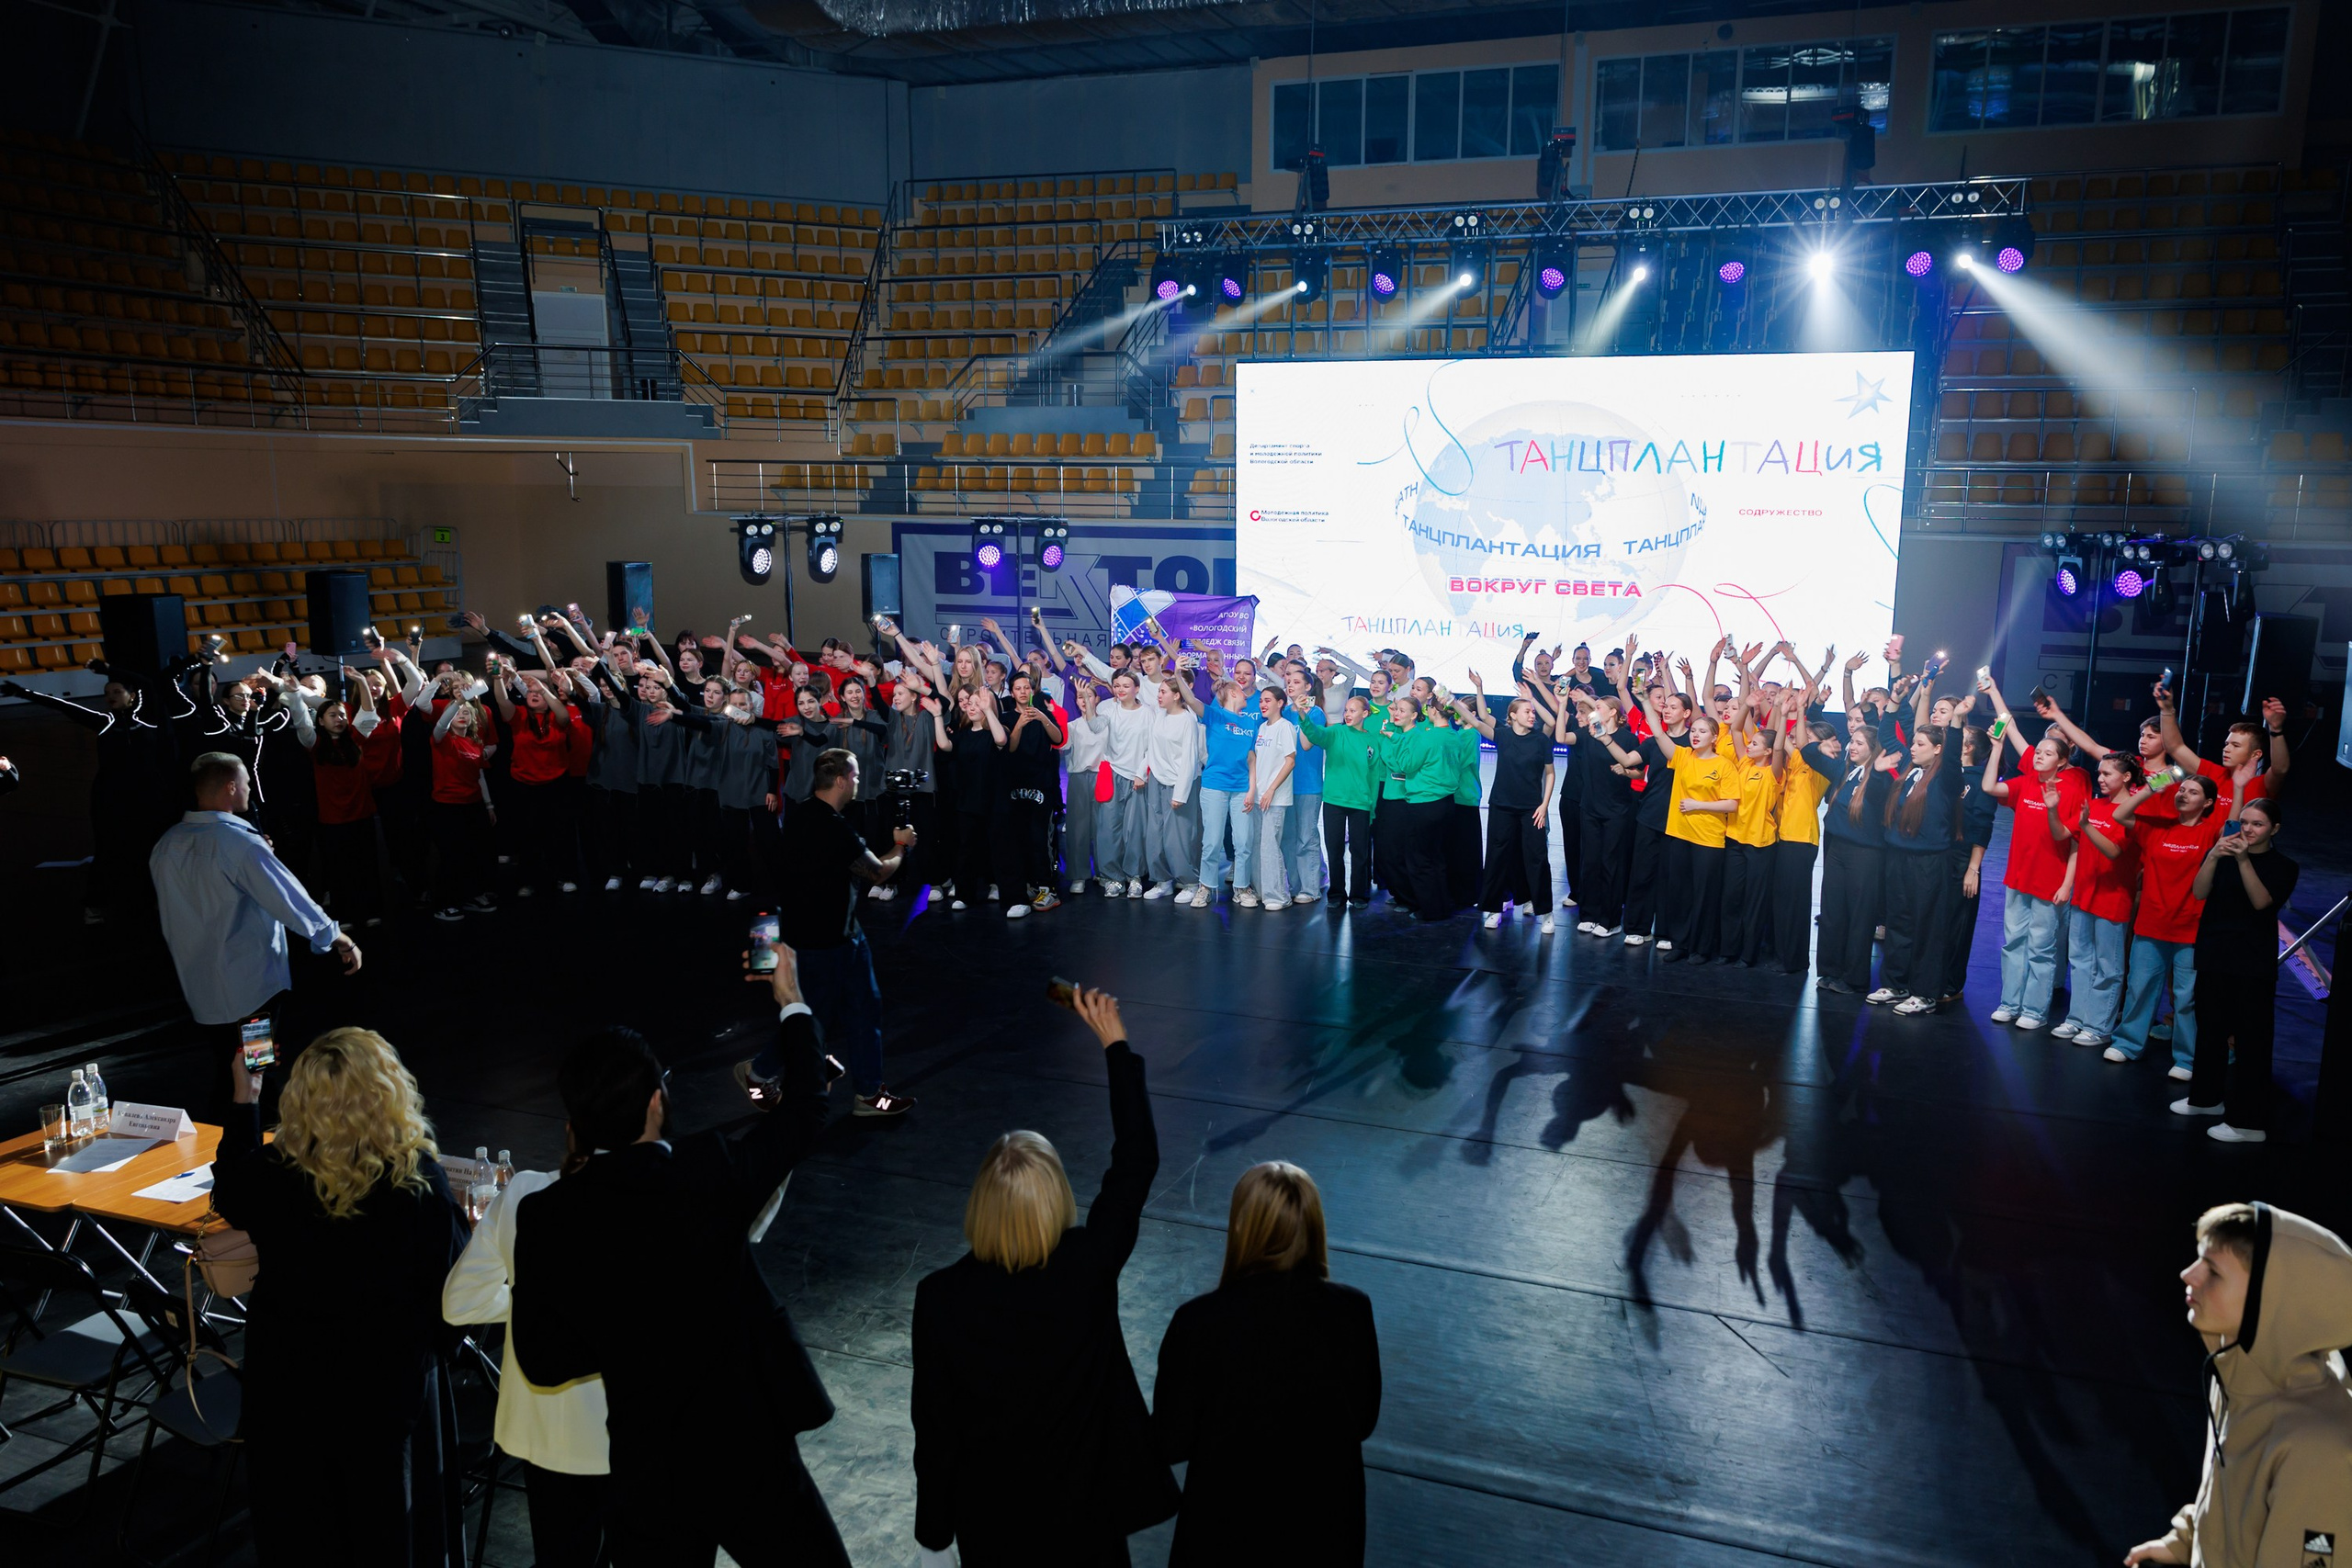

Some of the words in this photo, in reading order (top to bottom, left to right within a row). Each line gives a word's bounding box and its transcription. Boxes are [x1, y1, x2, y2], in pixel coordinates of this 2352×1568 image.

[1494, 439, 1883, 476] ТАНЦПЛАНТАЦИЯ
[1738, 508, 1823, 517] СОДРУЖЕСТВО
[1403, 514, 1601, 560] ТАНЦПЛАНТАЦИЯ
[1450, 577, 1547, 594] ВОКРУГ
[1555, 579, 1643, 598] СВЕТА
[1223, 638, 1245, 647] СВЯЗИ
[876, 1097, 892, 1111] N
